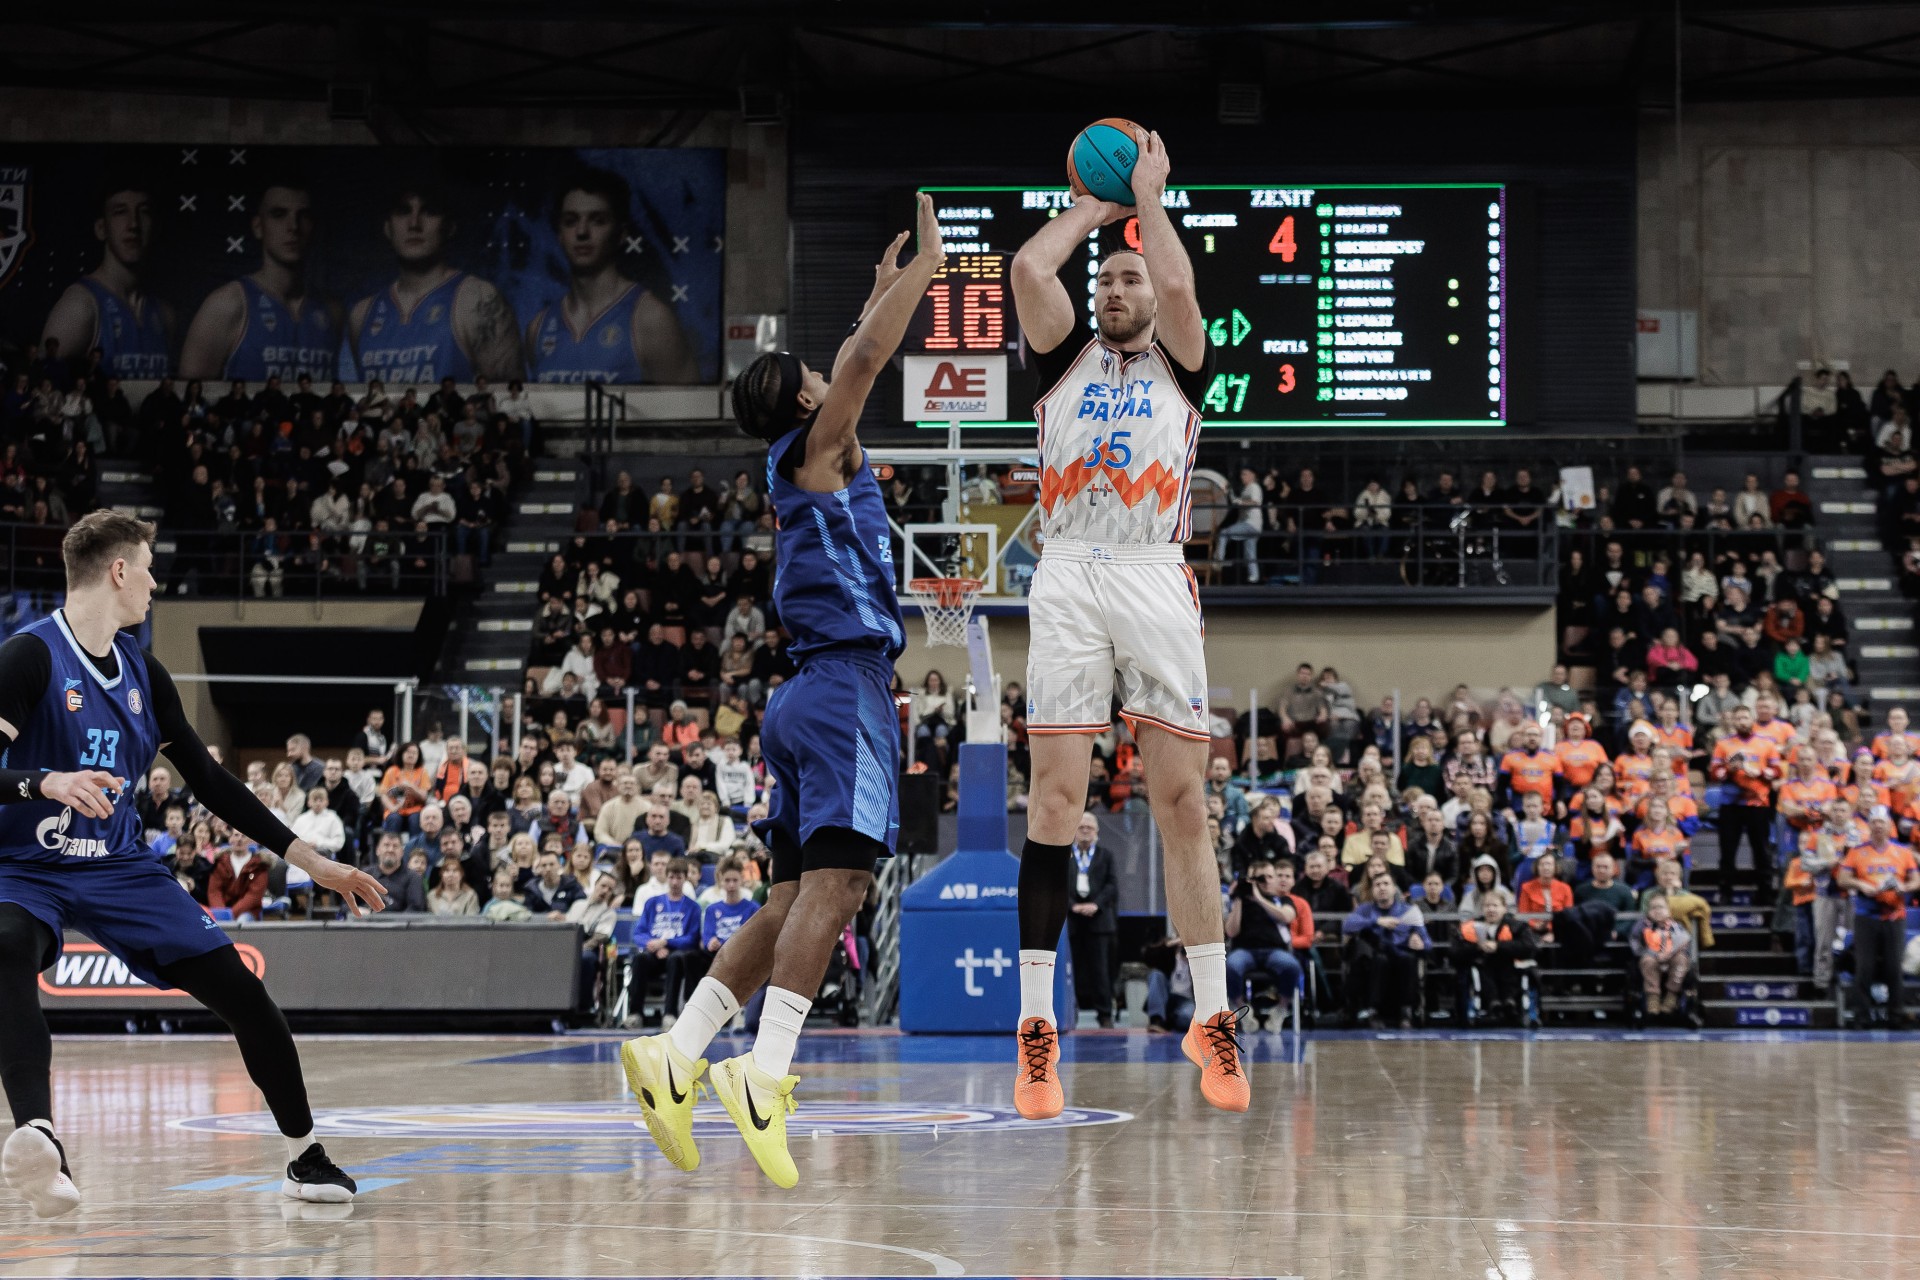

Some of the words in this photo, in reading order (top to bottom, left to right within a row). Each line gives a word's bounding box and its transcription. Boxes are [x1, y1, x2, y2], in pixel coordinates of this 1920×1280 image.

[1250, 188, 1316, 208] ZENIT
[1203, 234, 1216, 253] 1
[1268, 215, 1298, 263] 4
[925, 284, 1003, 349] 16
[1277, 364, 1296, 393] 3
[80, 728, 120, 768] 33
